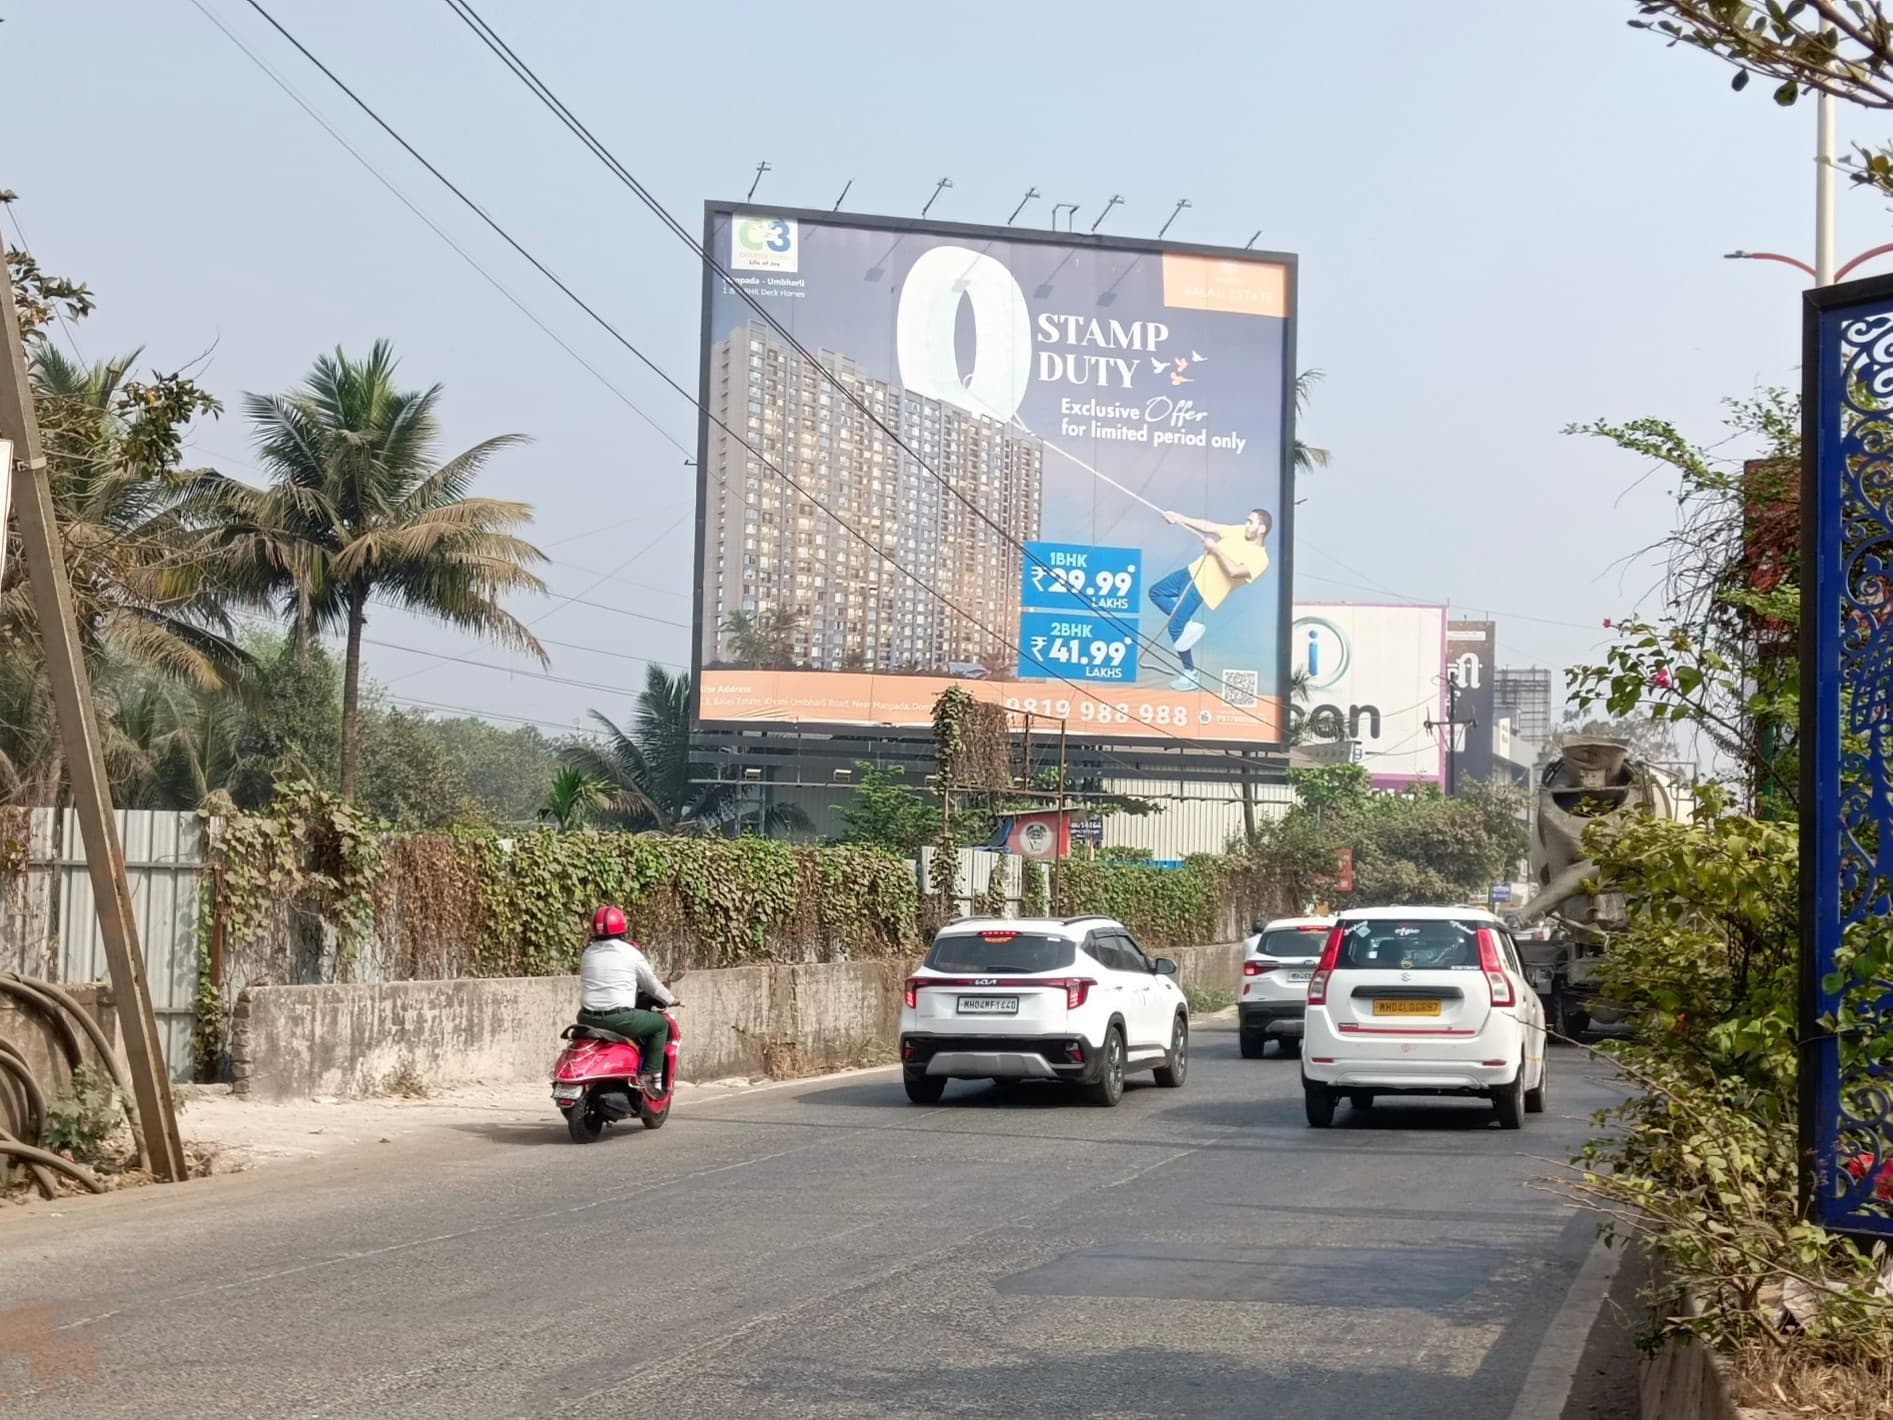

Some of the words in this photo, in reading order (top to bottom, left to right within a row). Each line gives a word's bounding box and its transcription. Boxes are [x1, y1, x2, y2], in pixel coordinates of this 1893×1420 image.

[1037, 312, 1169, 351] STAMP
[1038, 351, 1140, 389] DUTY
[1061, 398, 1140, 419] Exclusive
[1144, 395, 1208, 427] Offer
[1061, 419, 1086, 436] for
[1091, 421, 1148, 442] limited
[1153, 427, 1206, 448] period
[1211, 431, 1247, 454] only
[1050, 552, 1087, 568] 1BHK
[1092, 597, 1129, 609] LAKHS
[1050, 622, 1093, 638] 2BHK
[1086, 666, 1123, 678] LAKHS
[1080, 701, 1129, 724] 988
[1139, 704, 1188, 727] 988
